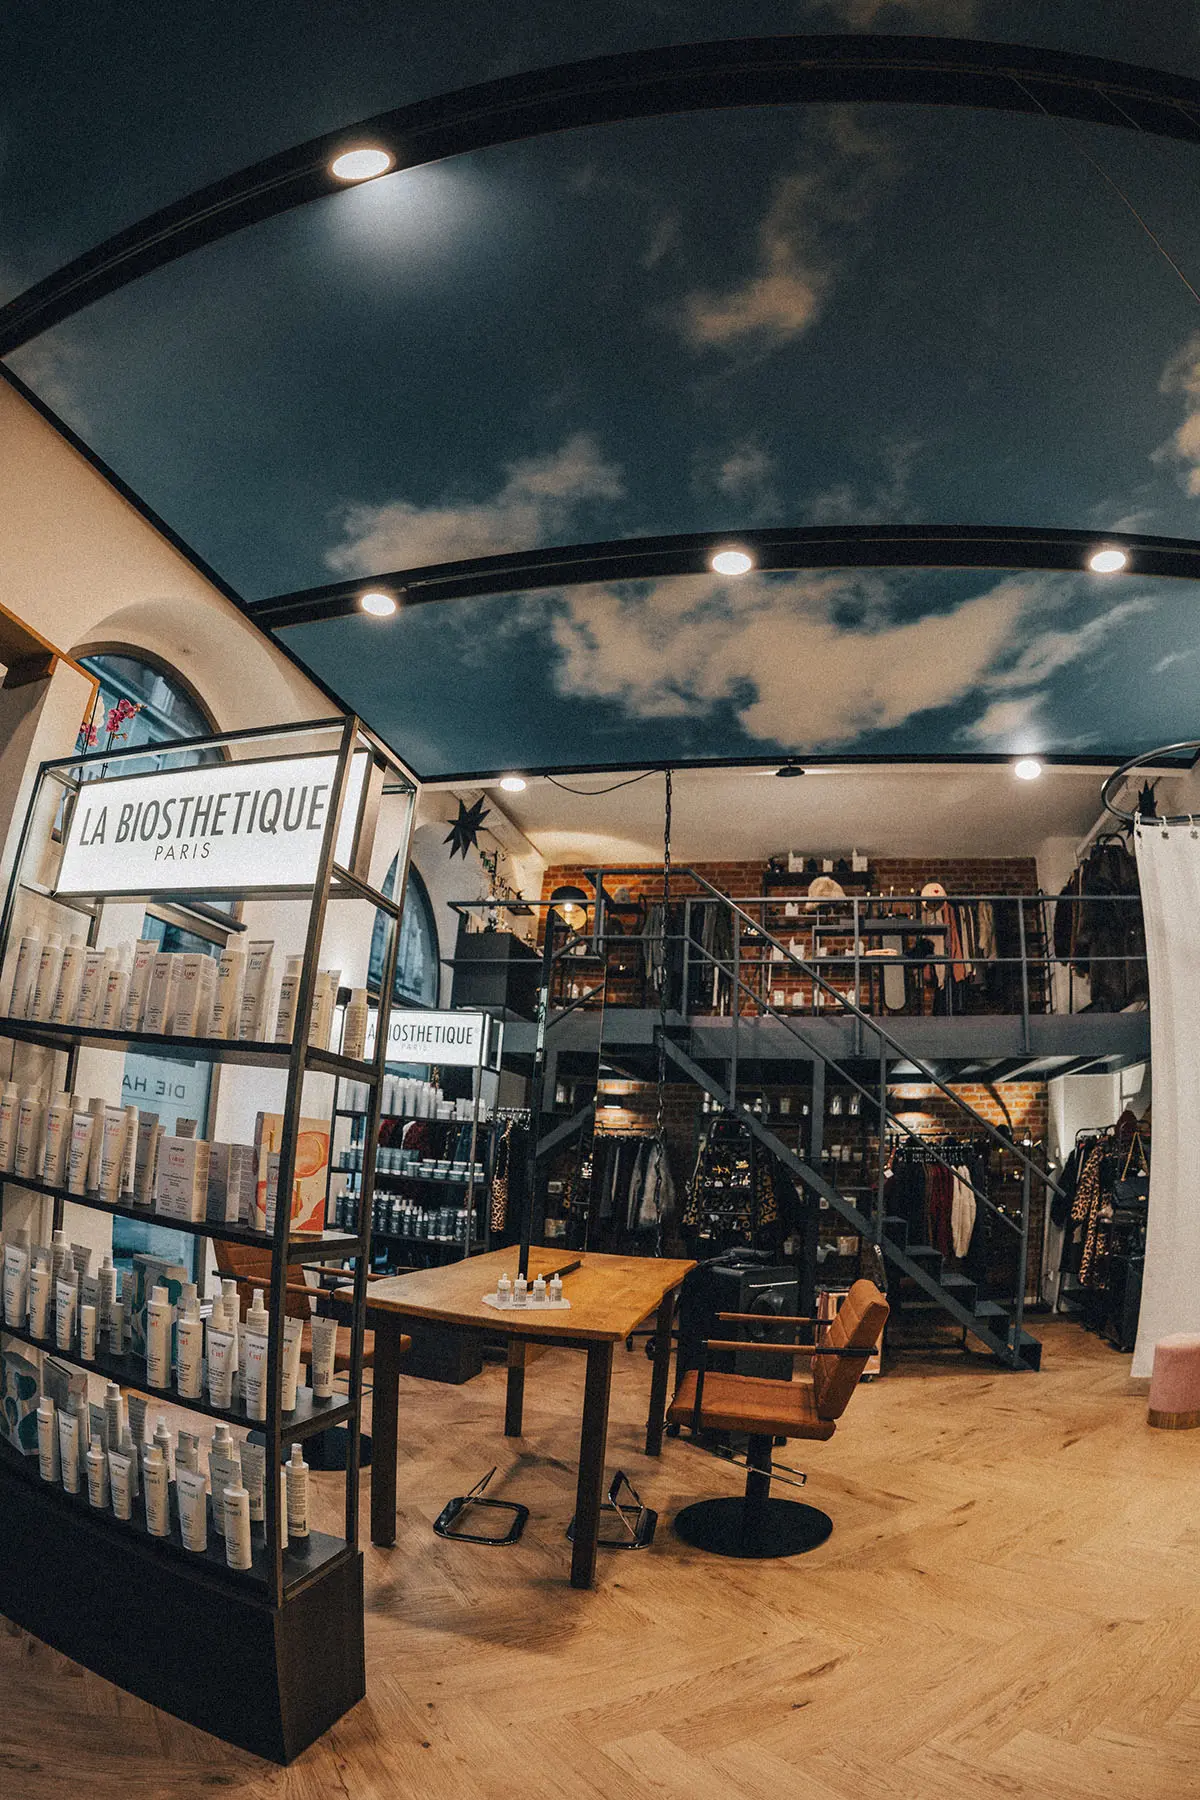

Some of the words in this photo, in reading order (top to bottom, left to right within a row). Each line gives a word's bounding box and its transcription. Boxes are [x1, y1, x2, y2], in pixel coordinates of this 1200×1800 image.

[79, 806, 108, 846] LA
[115, 784, 329, 843] BIOSTHETIQUE
[154, 842, 211, 861] PARIS
[388, 1023, 474, 1045] IOSTHETIQUE
[401, 1043, 428, 1052] PARIS
